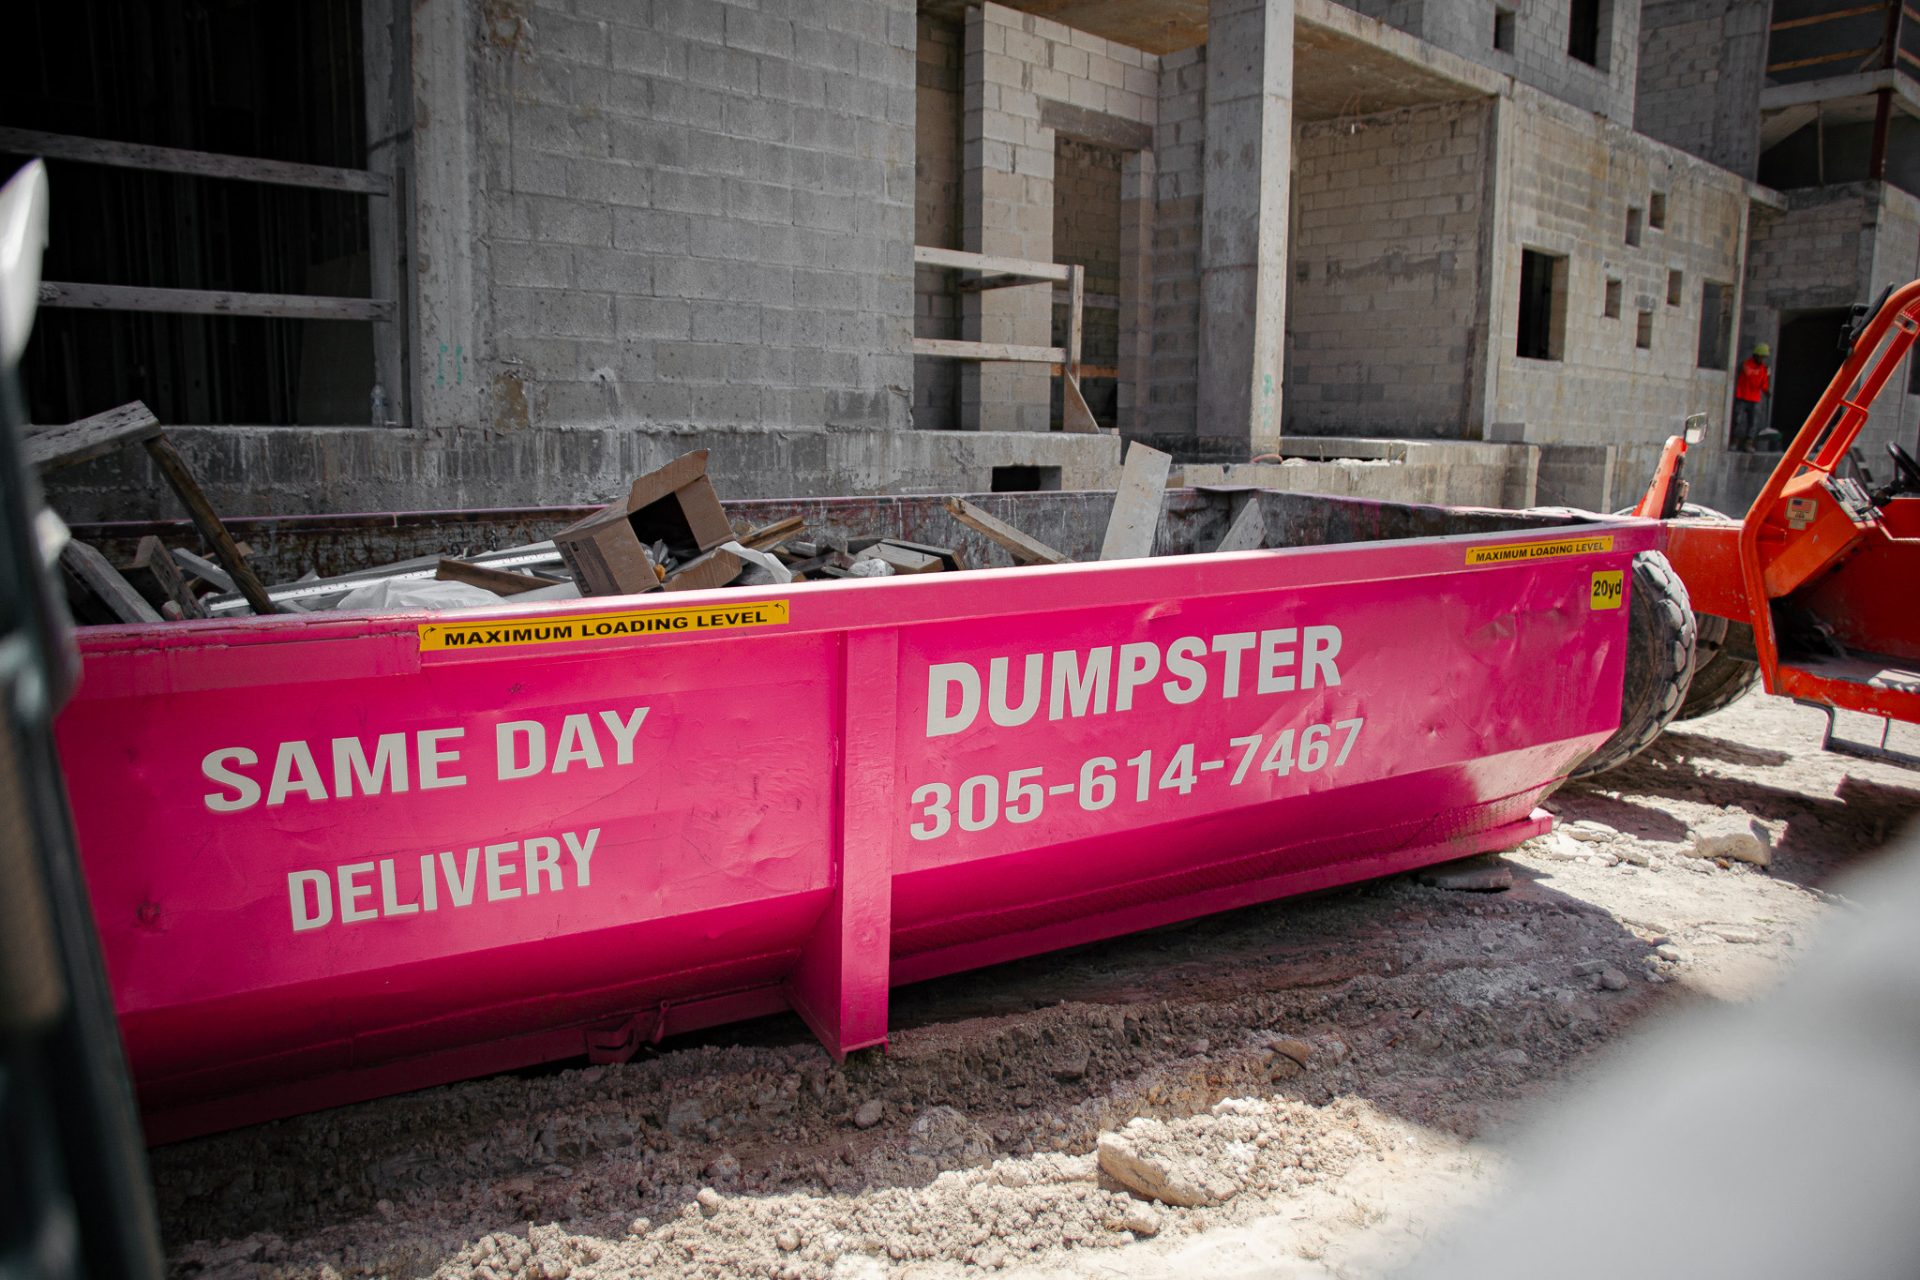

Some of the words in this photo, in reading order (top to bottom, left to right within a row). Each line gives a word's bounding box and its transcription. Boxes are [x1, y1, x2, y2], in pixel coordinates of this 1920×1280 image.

[1475, 549, 1527, 562] MAXIMUM
[1530, 544, 1573, 557] LOADING
[1575, 542, 1604, 553] LEVEL
[1593, 579, 1622, 599] 20yd
[444, 626, 572, 646] MAXIMUM
[581, 616, 688, 637] LOADING
[697, 611, 767, 628] LEVEL
[926, 625, 1343, 738] DUMPSTER
[201, 727, 467, 813] SAME
[496, 707, 651, 781] DAY
[910, 717, 1364, 841] 305-614-7467
[287, 827, 601, 932] DELIVERY
